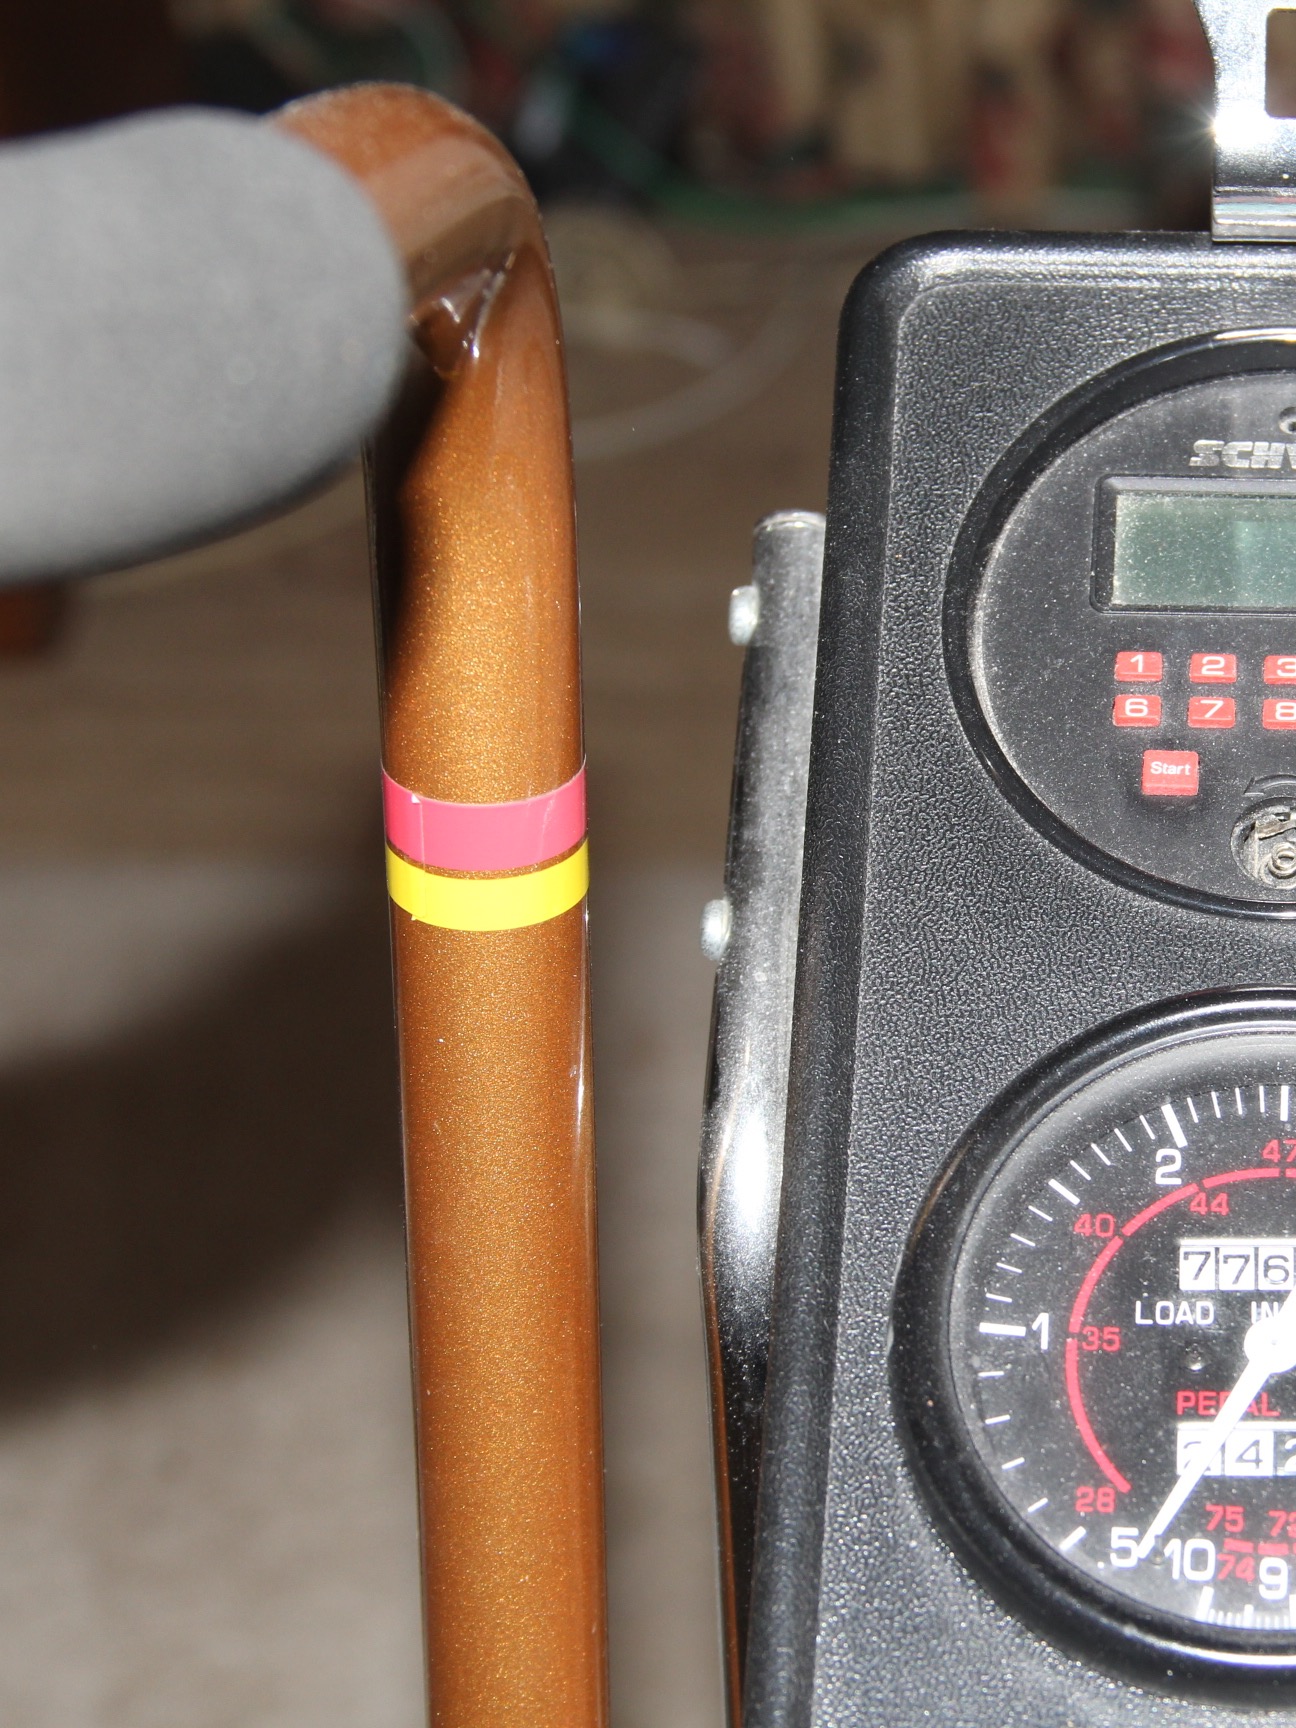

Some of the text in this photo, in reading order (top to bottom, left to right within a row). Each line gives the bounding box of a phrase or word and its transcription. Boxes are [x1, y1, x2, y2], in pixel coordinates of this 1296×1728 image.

[1130, 655, 1145, 673] 1
[1201, 656, 1225, 676] 2
[1125, 698, 1148, 717] 6
[1200, 701, 1224, 718] 7
[1150, 761, 1191, 776] Start
[1155, 1148, 1183, 1185] 2
[1188, 1192, 1230, 1217] 44
[1073, 1213, 1116, 1238] 40
[1134, 1300, 1215, 1326] LOAD
[1031, 1312, 1050, 1351] 1
[1081, 1326, 1121, 1353] 35
[1074, 1486, 1117, 1514] 28
[1205, 1504, 1245, 1533] 75
[1163, 1538, 1217, 1582] 10
[1217, 1552, 1256, 1583] 74
[1258, 1556, 1289, 1601] 9
